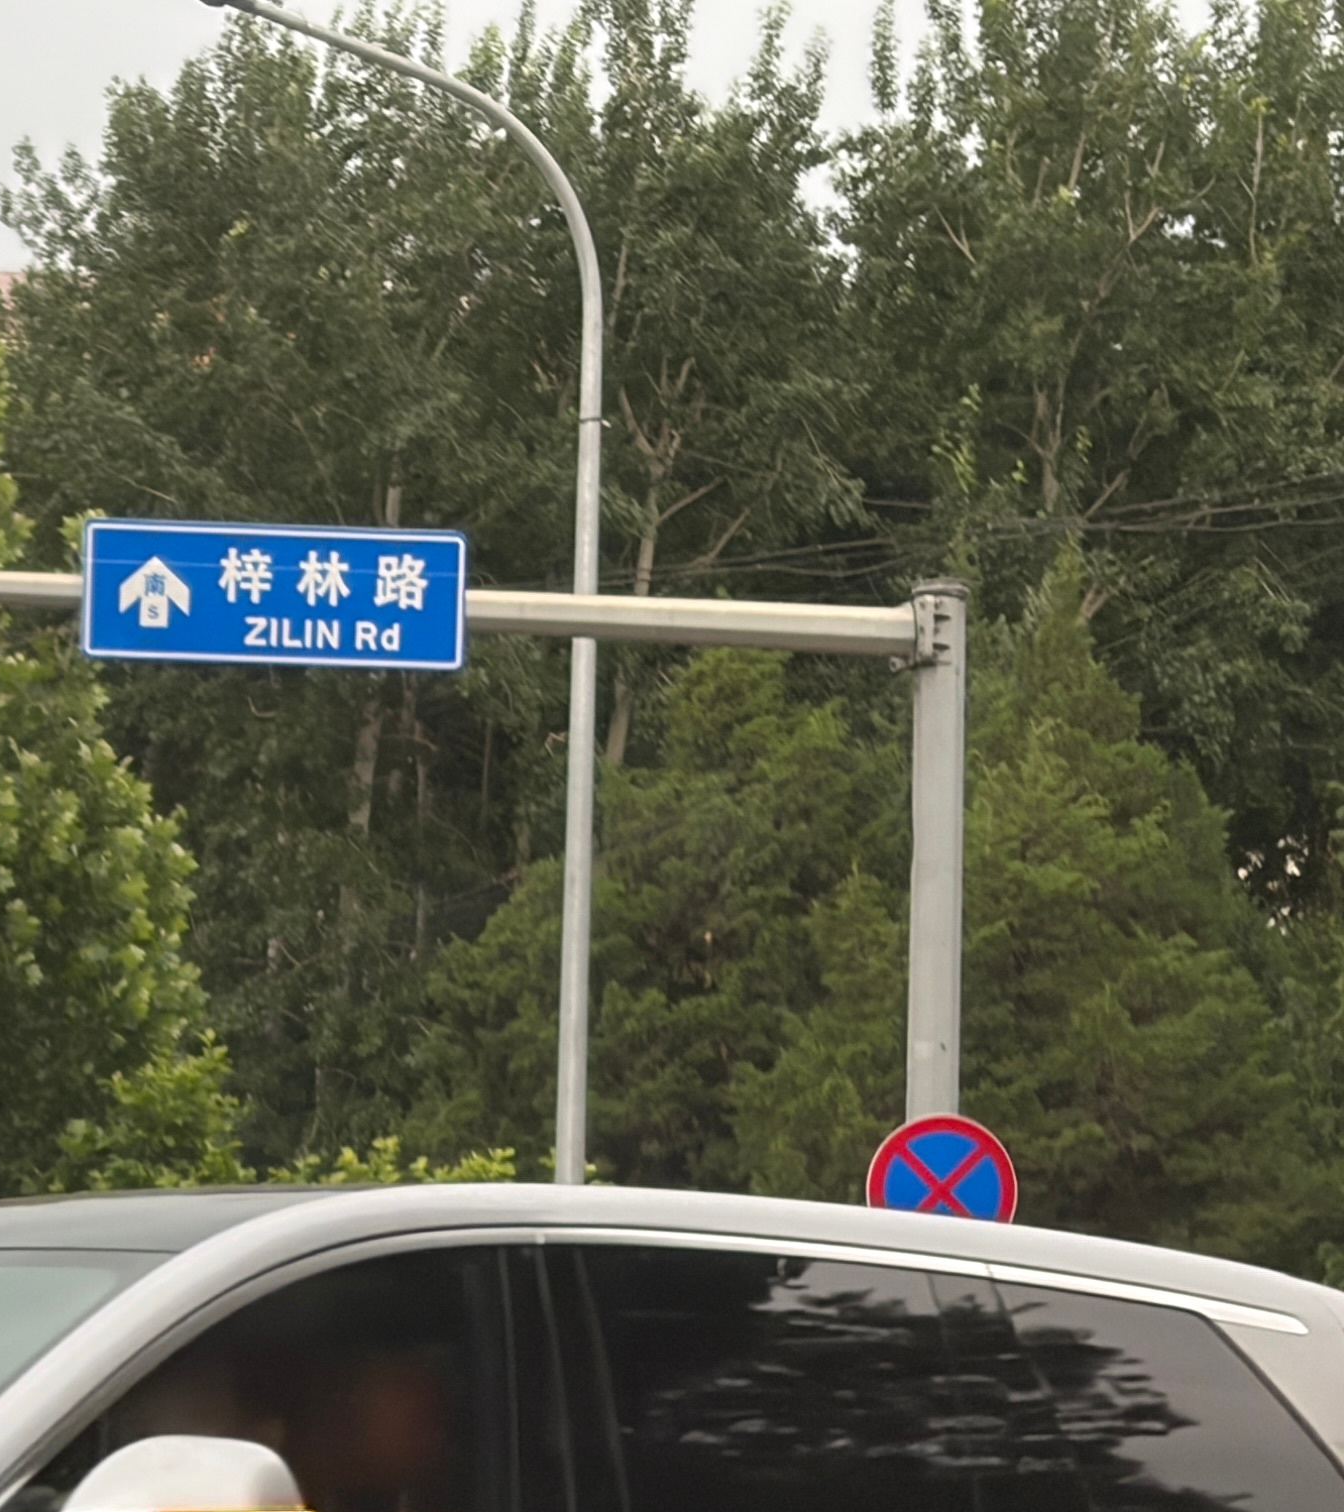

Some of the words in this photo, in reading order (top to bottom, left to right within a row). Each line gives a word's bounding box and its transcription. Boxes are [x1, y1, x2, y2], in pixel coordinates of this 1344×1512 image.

[218, 547, 428, 610] 梓林路
[147, 604, 159, 619] S
[243, 617, 339, 649] ZILIN
[355, 622, 401, 651] Rd
